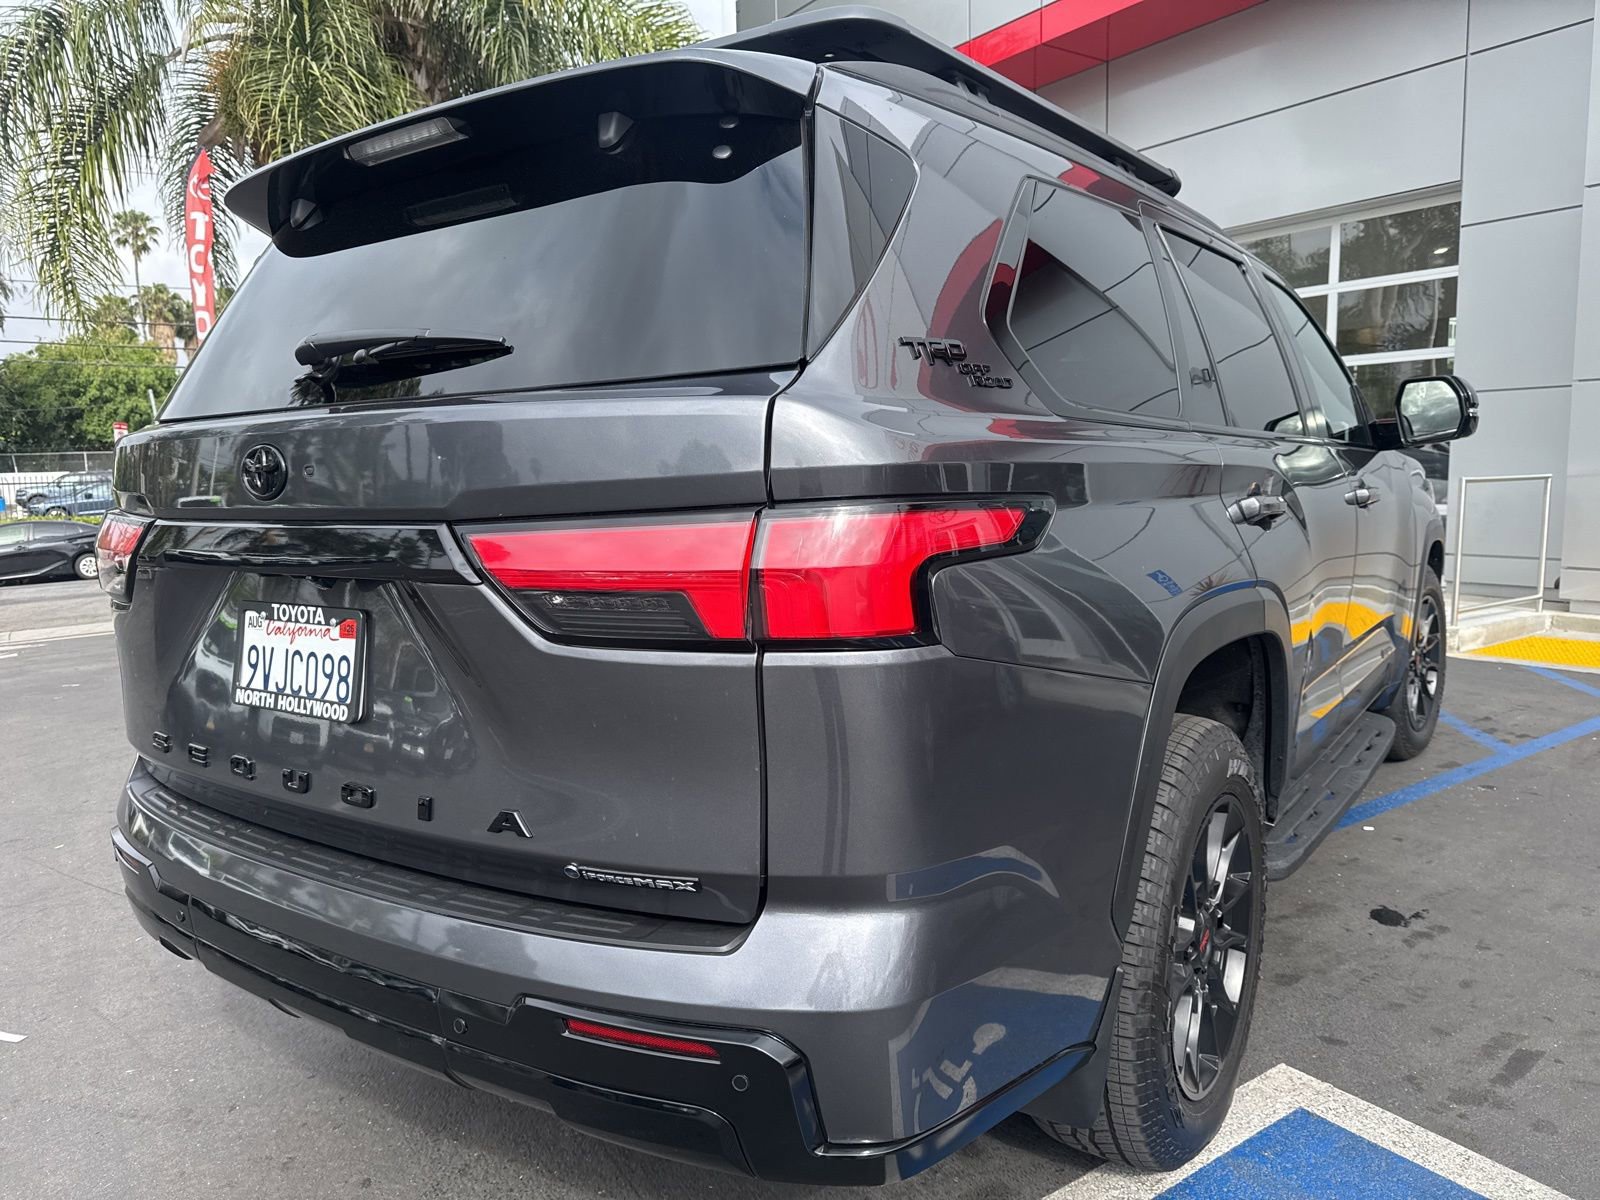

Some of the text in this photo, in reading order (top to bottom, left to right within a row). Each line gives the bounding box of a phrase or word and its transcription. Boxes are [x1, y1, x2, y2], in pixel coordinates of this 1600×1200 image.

[898, 336, 967, 366] TRD
[247, 615, 263, 629] AUG
[271, 603, 325, 625] TOYOTA
[265, 619, 339, 645] California
[247, 644, 351, 704] 9VJC098
[235, 688, 349, 722] NORTH HOLLYWOOD
[152, 730, 534, 839] SEQUOIA
